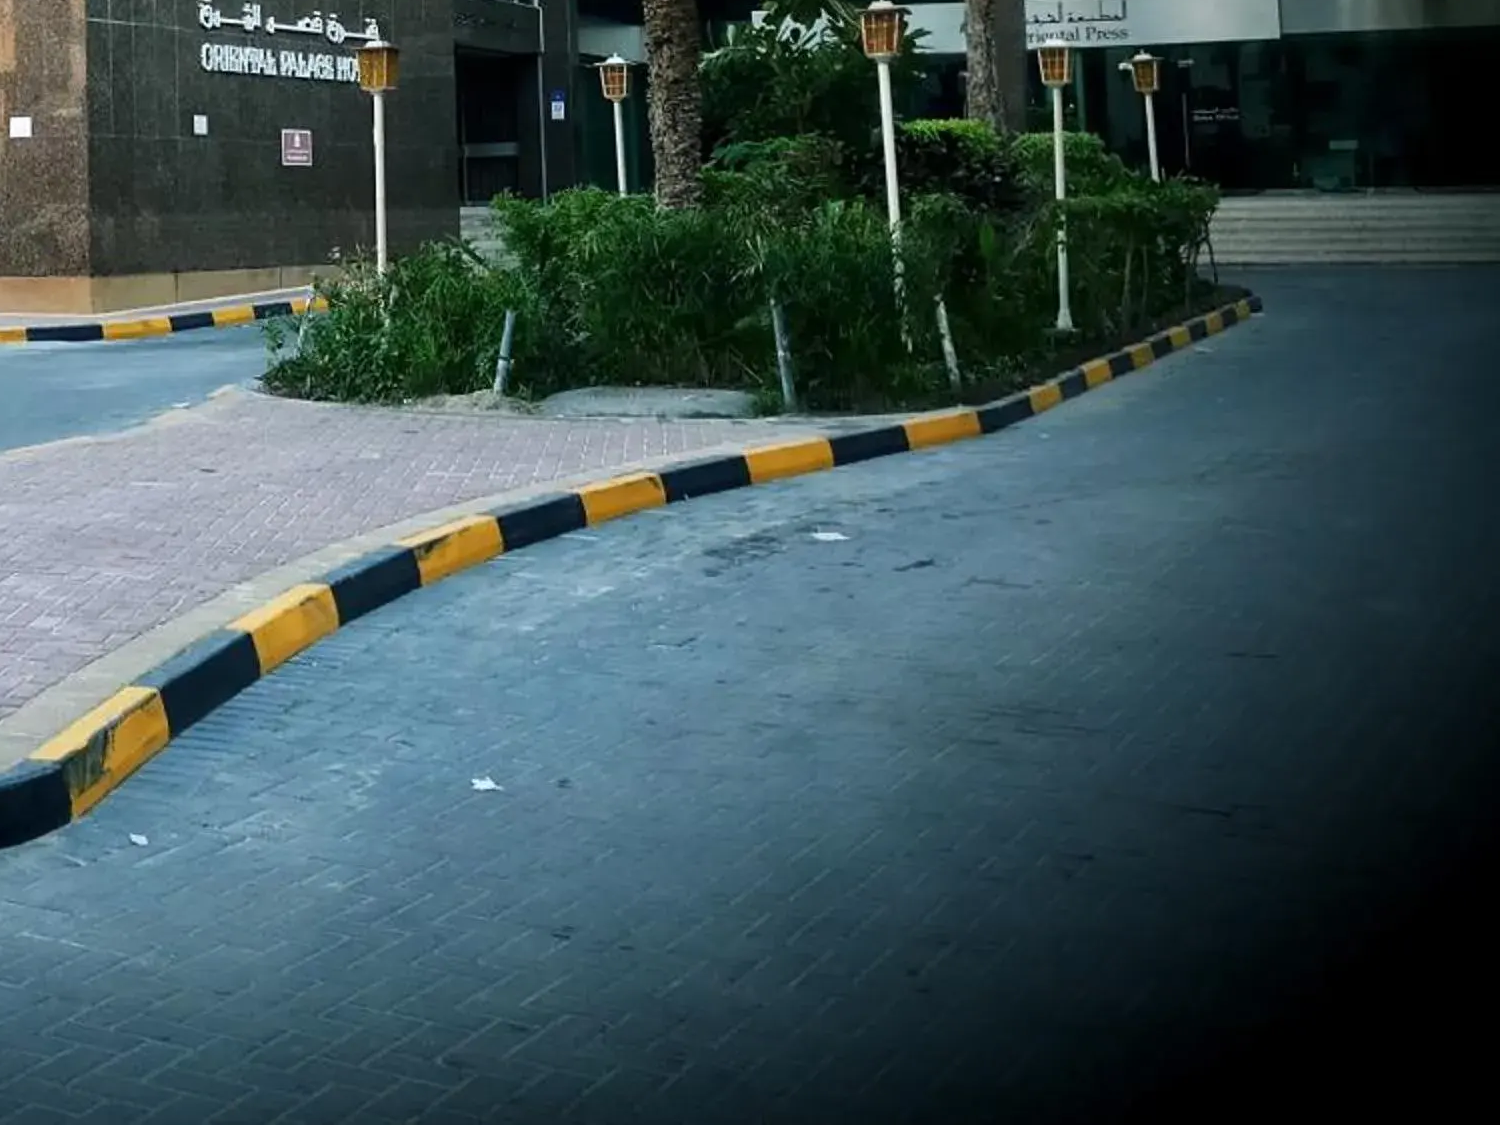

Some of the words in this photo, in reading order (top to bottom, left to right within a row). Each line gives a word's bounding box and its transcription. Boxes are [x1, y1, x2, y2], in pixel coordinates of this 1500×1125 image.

[1027, 27, 1081, 44] riental
[1085, 26, 1129, 43] Press
[201, 42, 277, 76] ORIENTAL
[279, 50, 335, 81] PALACE
